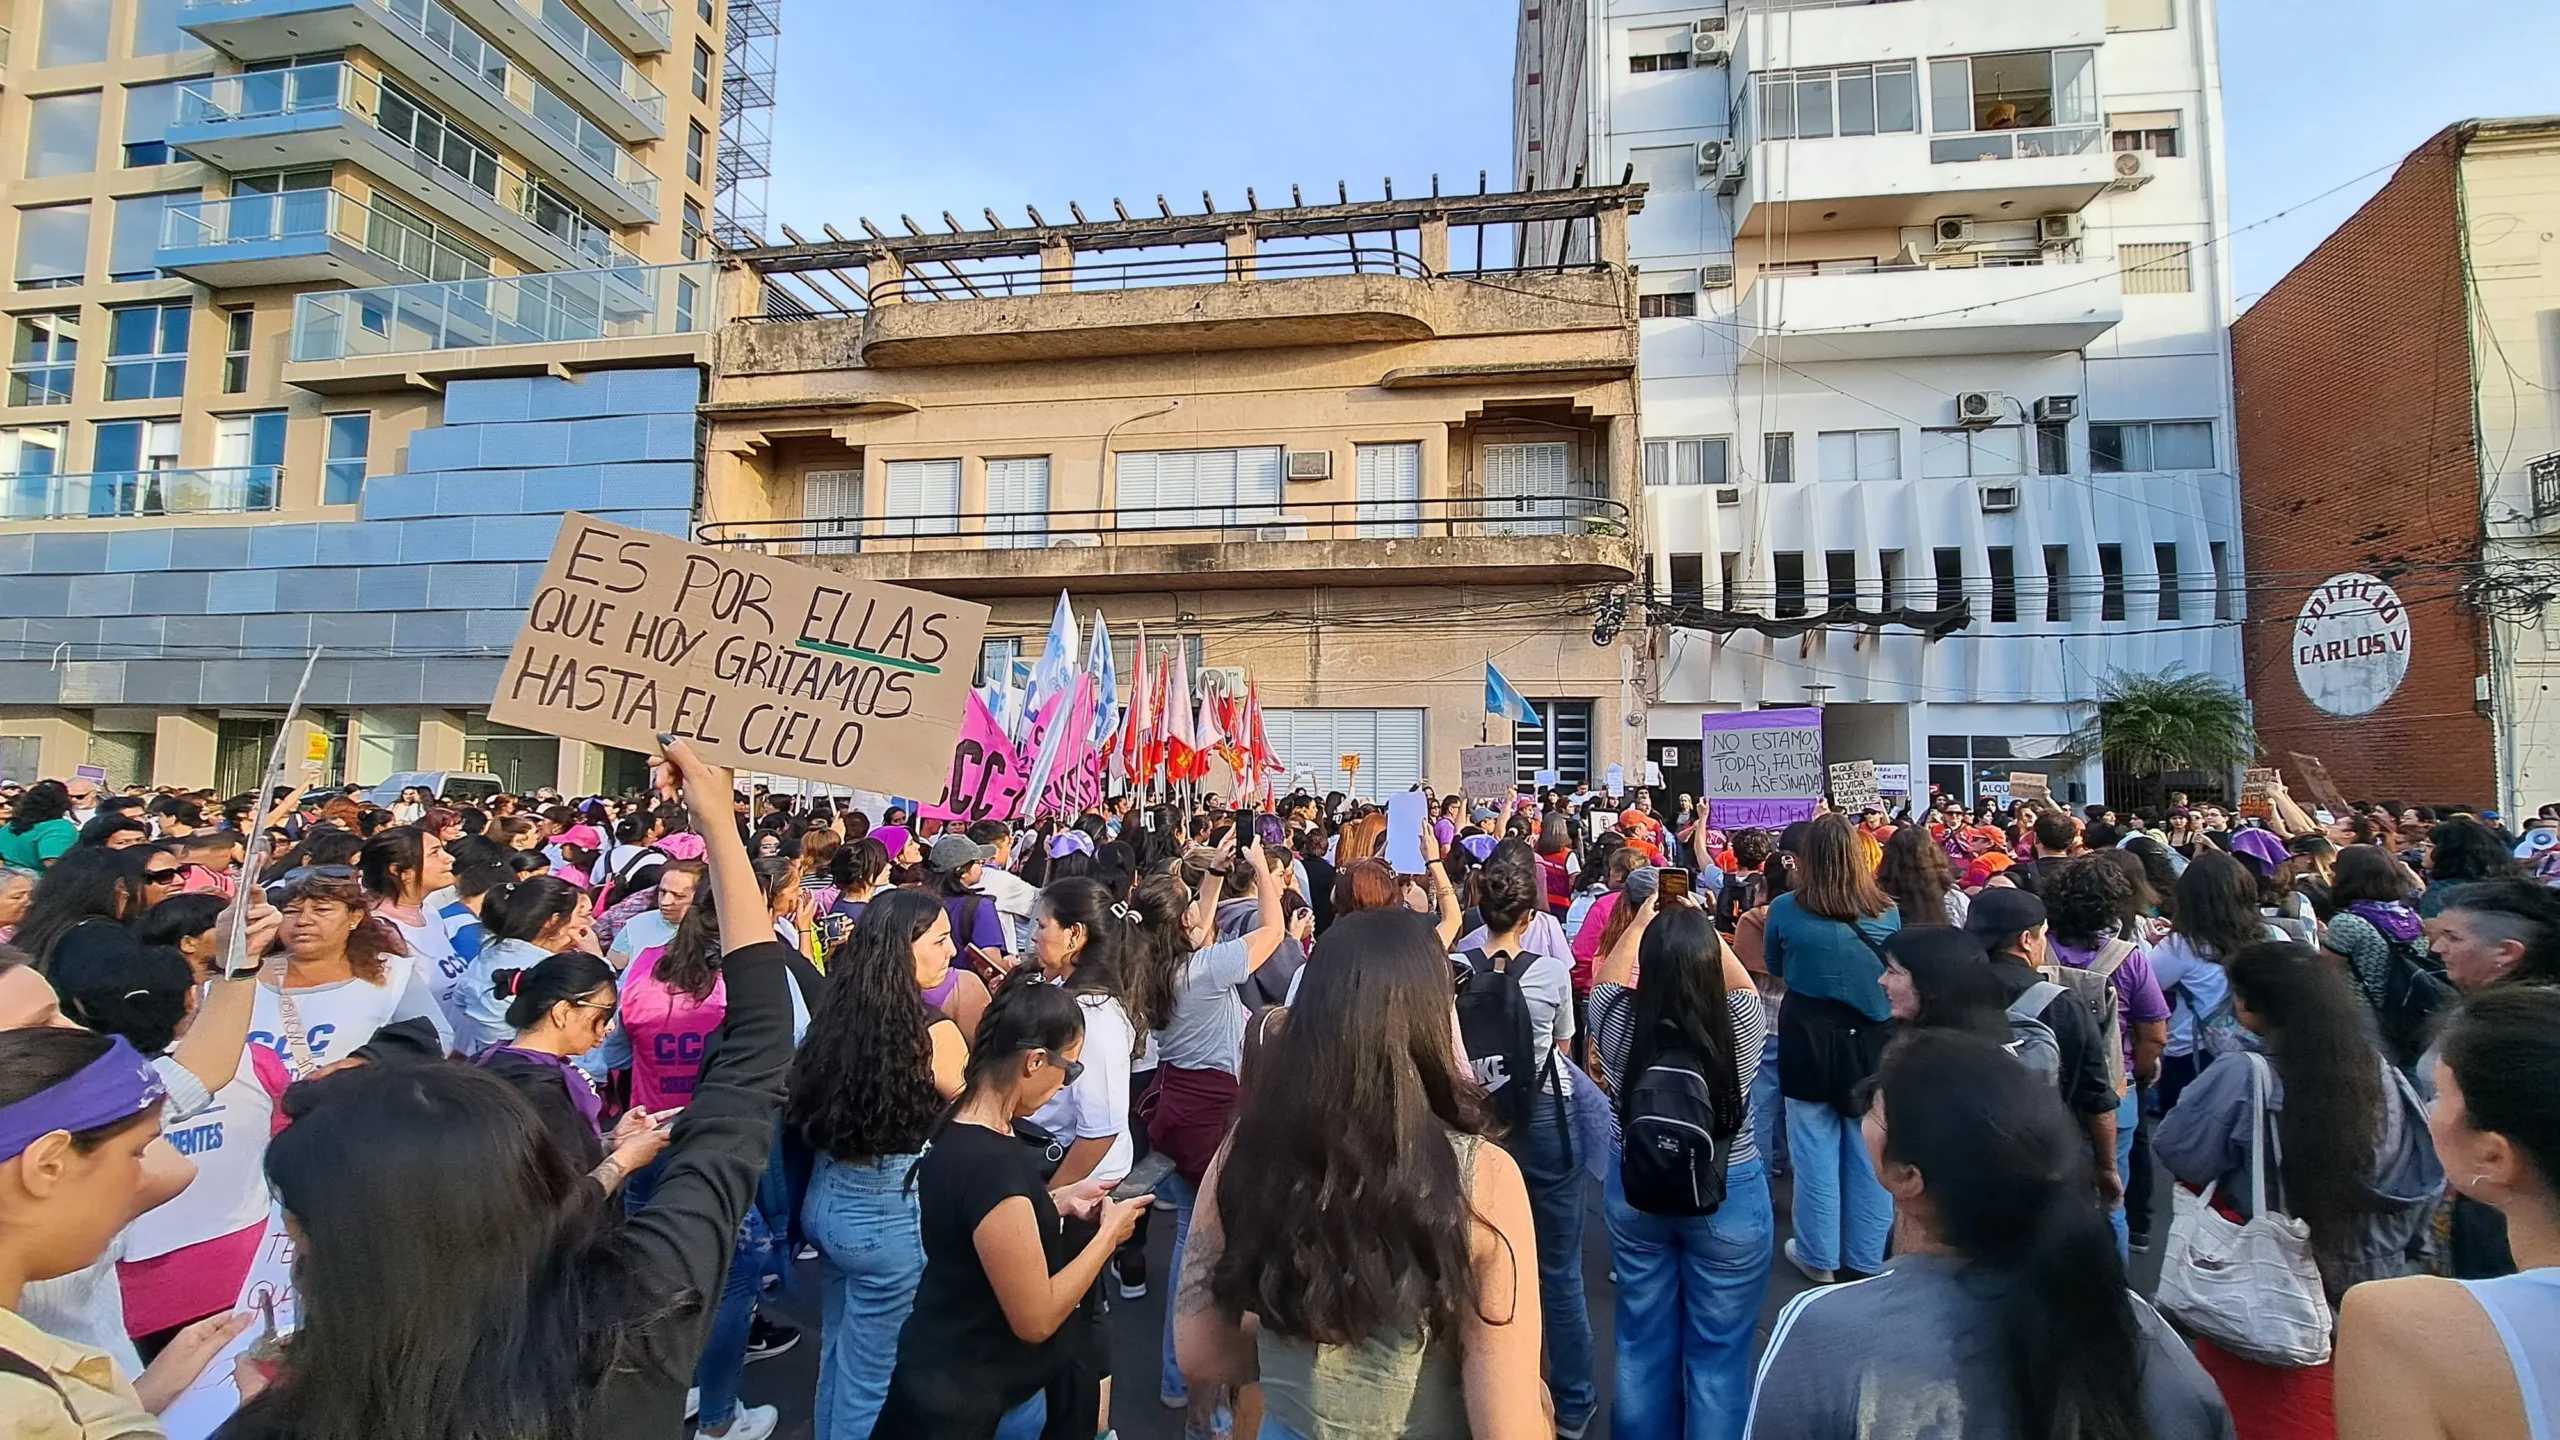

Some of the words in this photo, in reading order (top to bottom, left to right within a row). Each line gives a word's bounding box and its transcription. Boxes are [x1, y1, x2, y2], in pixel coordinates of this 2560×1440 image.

[565, 527, 651, 593] ES
[673, 554, 775, 635] POR
[800, 586, 949, 664] ELLAS
[2300, 579, 2399, 637] EDIFICIO
[529, 587, 615, 646] QUE
[625, 611, 708, 667] HOY
[2300, 633, 2386, 666] CARLOS
[2390, 629, 2407, 652] V
[511, 646, 657, 730] HASTA
[671, 686, 720, 744] EL
[1713, 733, 1740, 752] NO
[1752, 729, 1821, 753] ESTAMOS
[1714, 754, 1771, 776] TODAS,
[1772, 753, 1823, 772] FALTAN
[1832, 771, 1860, 781] MUJER
[1862, 770, 1872, 778] EN
[1839, 763, 1855, 772] QUE
[1714, 775, 1742, 793] las
[1833, 782, 1844, 790] TU
[1845, 780, 1866, 789] VIDA
[1981, 784, 2010, 793] ALQU
[1736, 803, 1773, 825] UNA
[1779, 802, 1816, 822] MEN
[654, 1032, 706, 1060] CC
